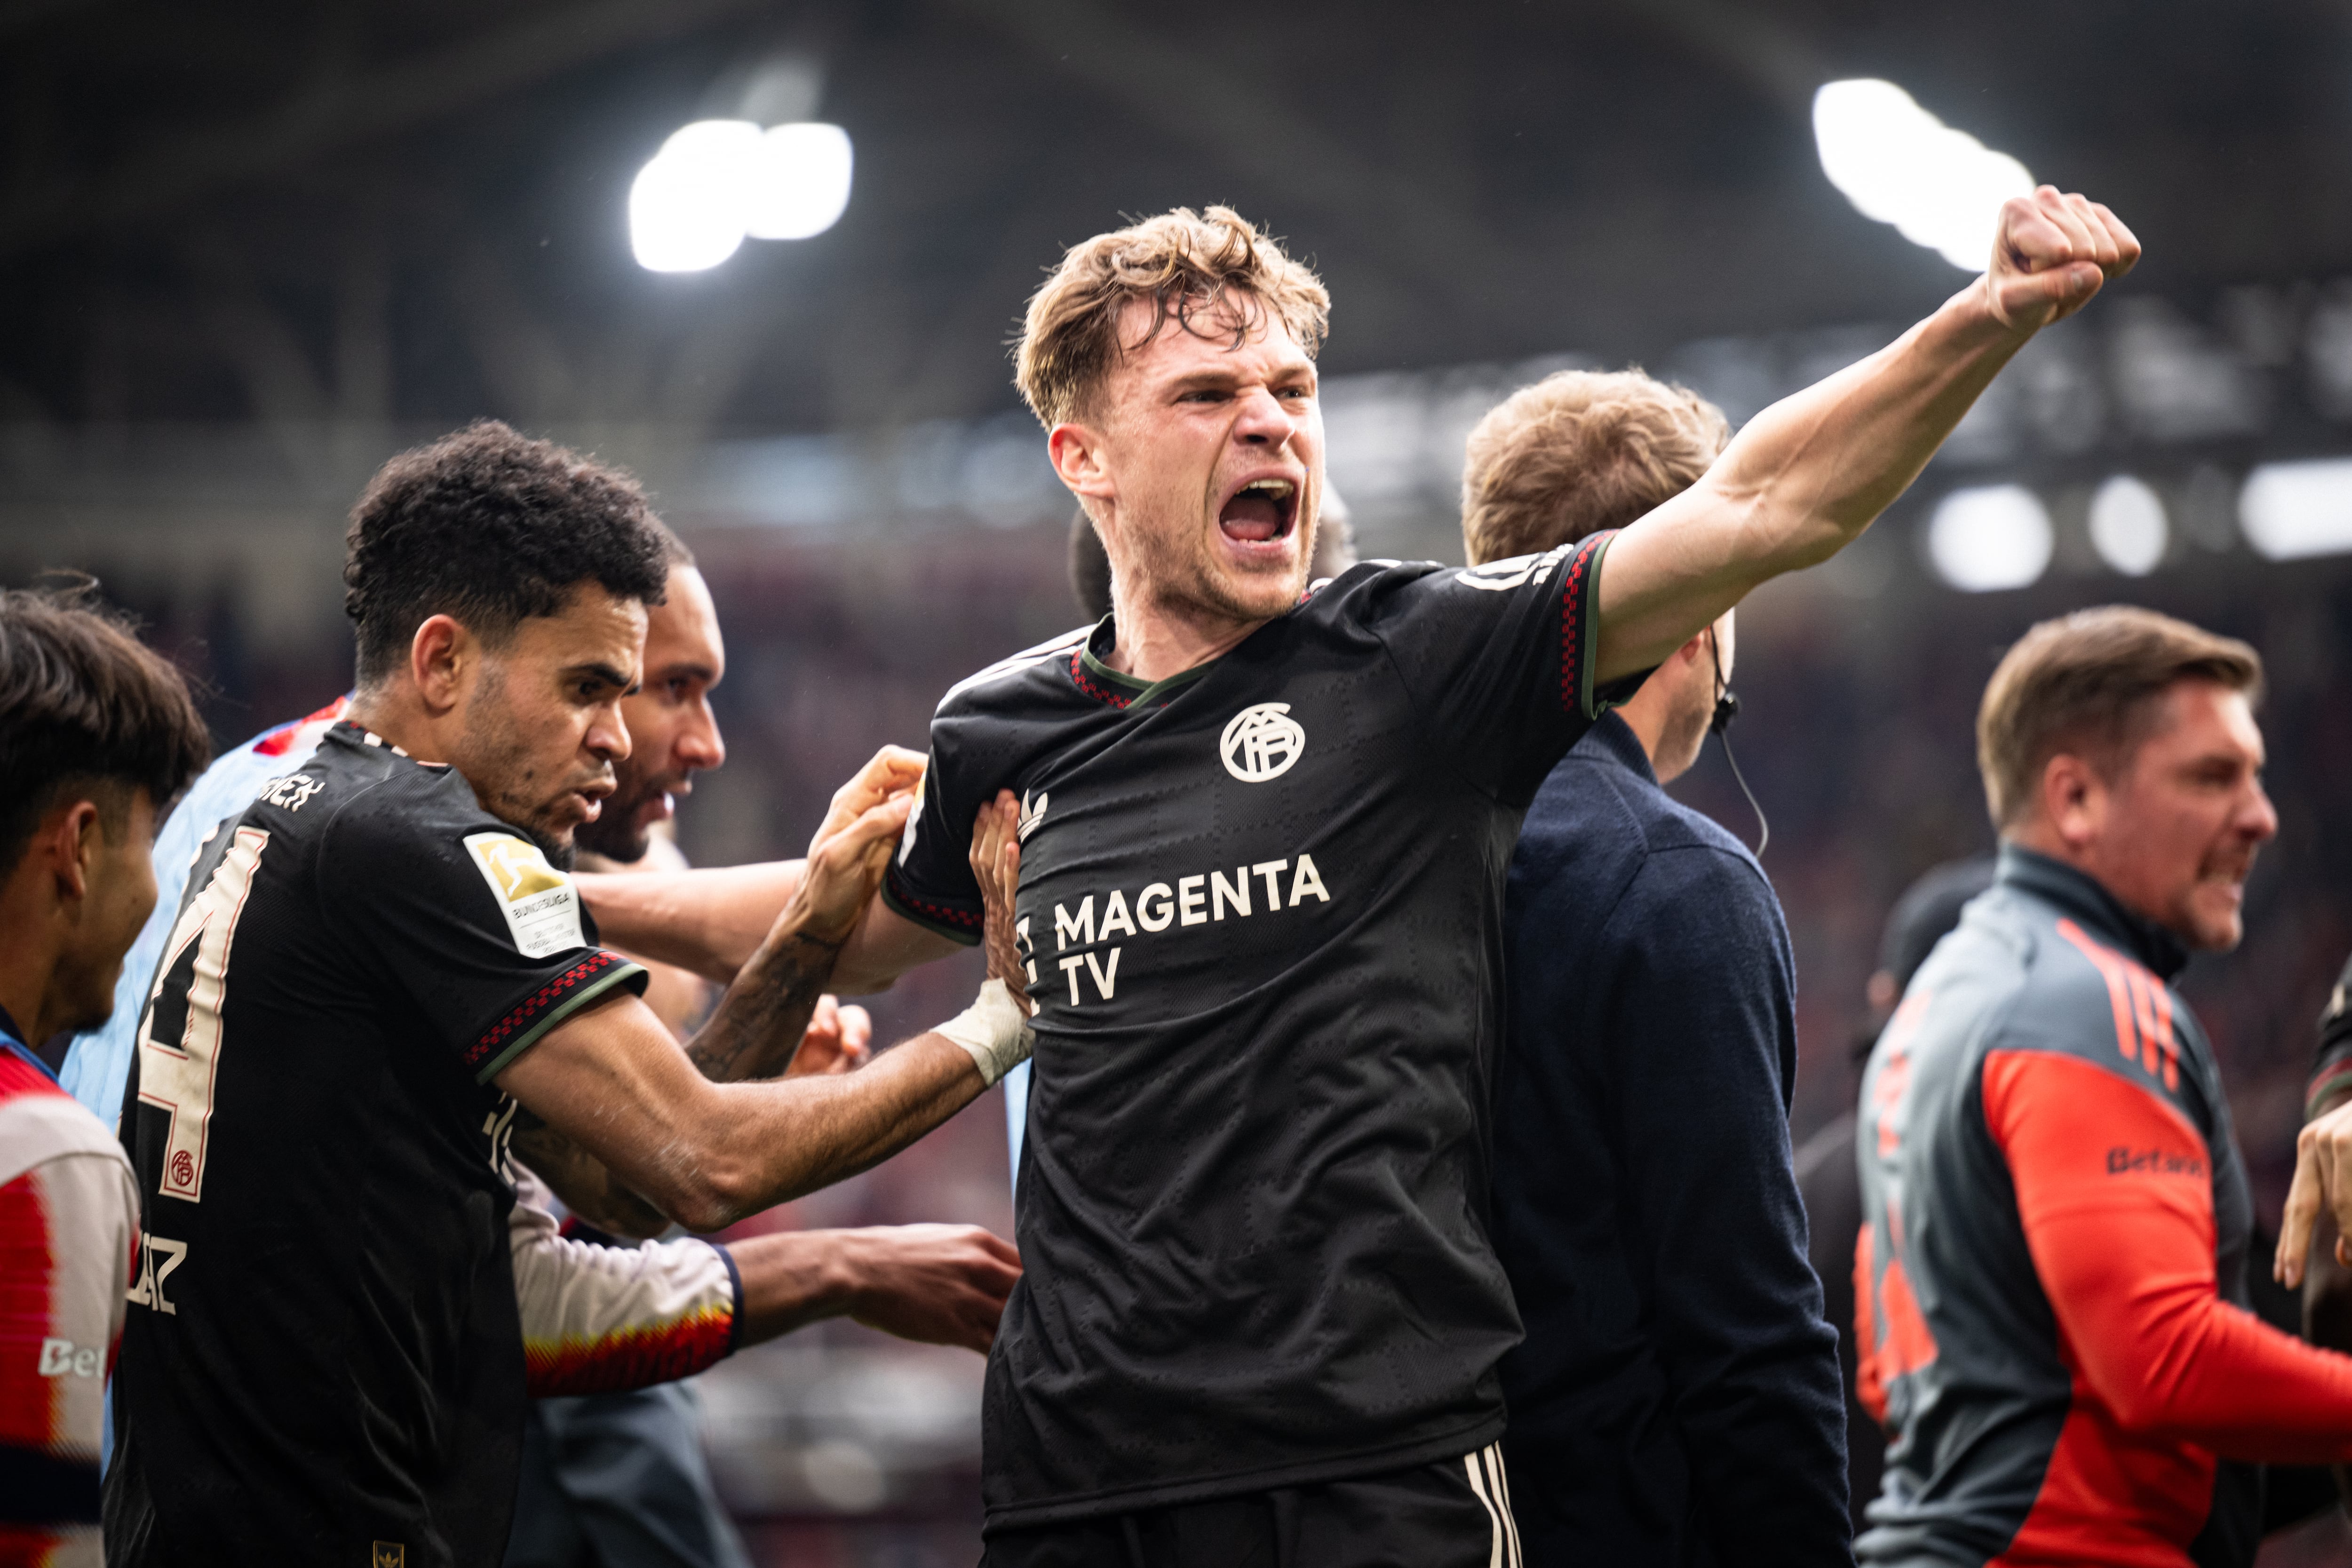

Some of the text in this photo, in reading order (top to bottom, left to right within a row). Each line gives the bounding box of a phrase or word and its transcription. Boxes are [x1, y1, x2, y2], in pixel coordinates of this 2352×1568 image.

[1055, 854, 1330, 951] MAGENTA
[118, 826, 271, 1203] 4
[1059, 948, 1121, 1006] TV
